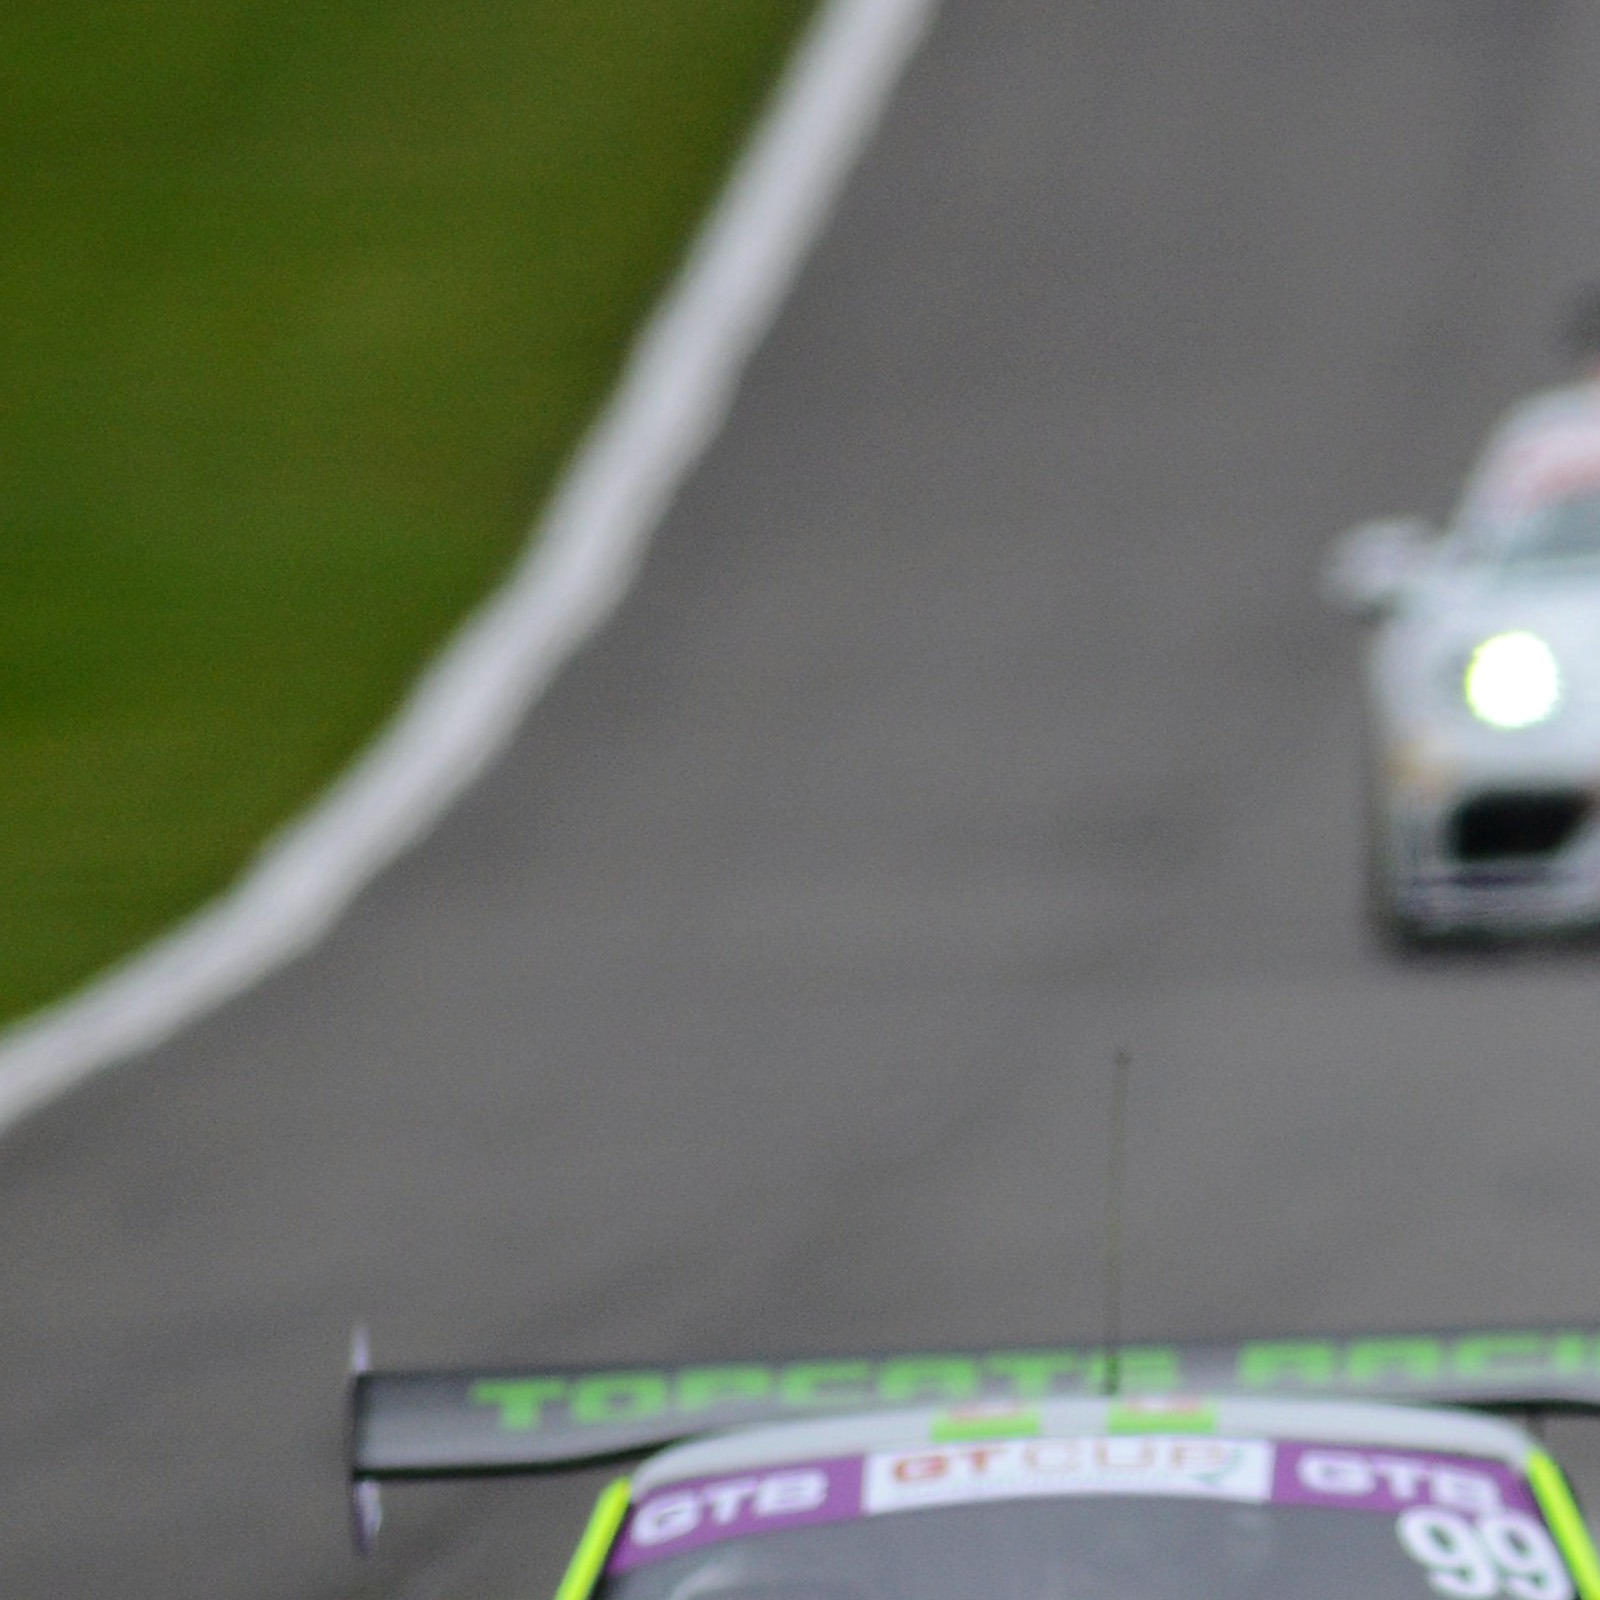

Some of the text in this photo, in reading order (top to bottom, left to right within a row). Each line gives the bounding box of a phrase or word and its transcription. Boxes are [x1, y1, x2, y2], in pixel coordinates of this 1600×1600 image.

[893, 1448, 998, 1483] GT
[1298, 1449, 1502, 1510] GTB
[630, 1466, 830, 1546] GTB
